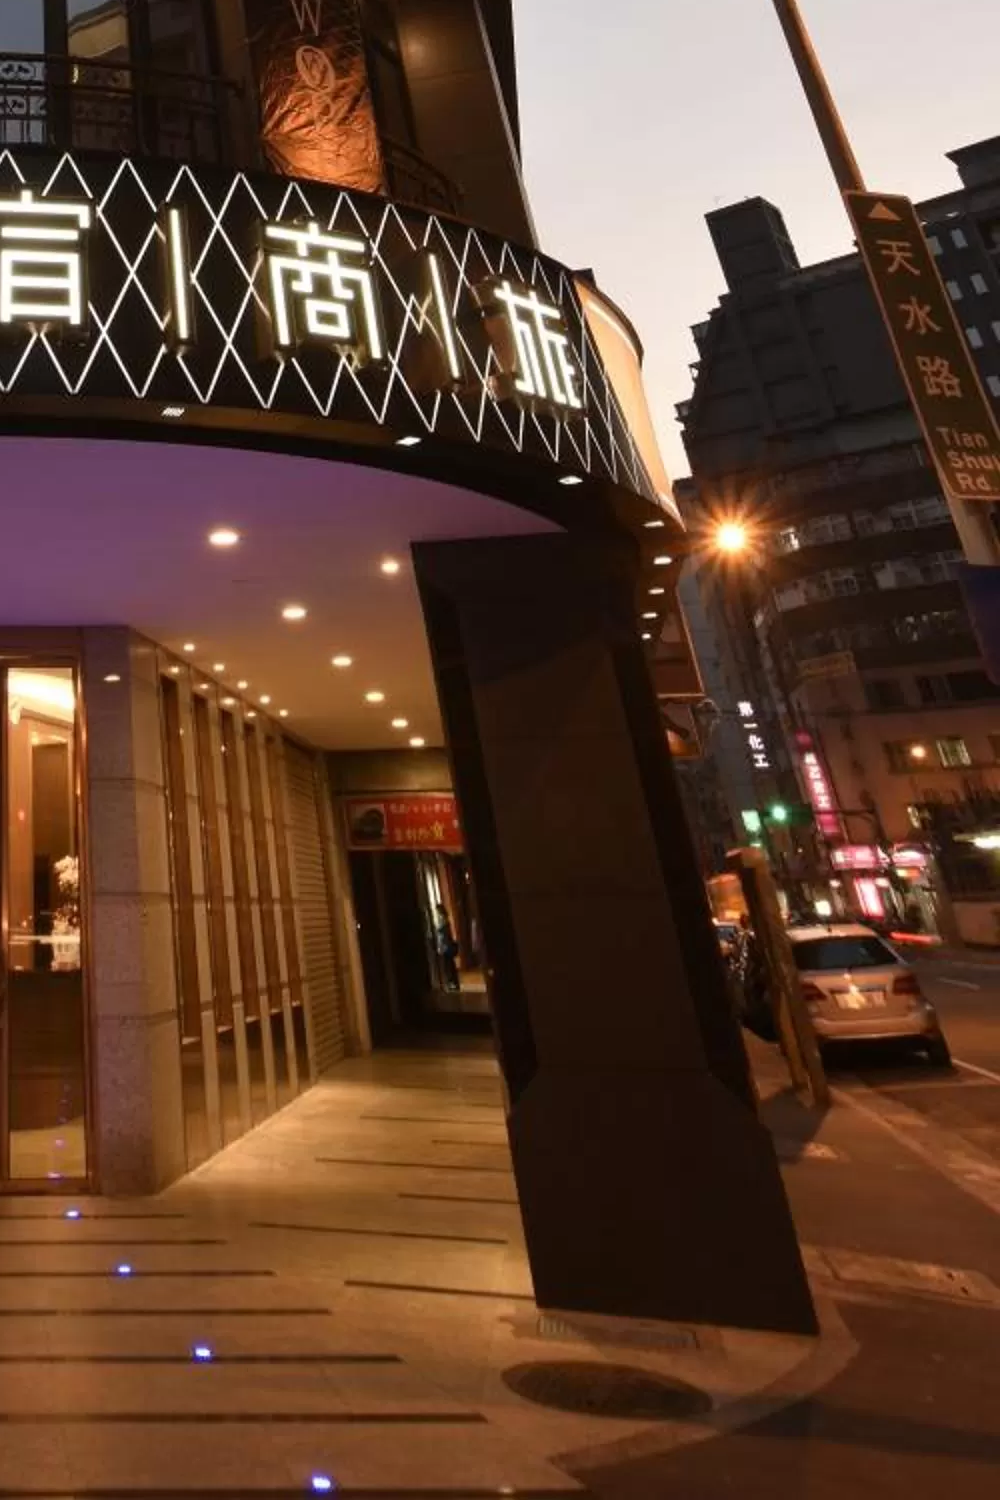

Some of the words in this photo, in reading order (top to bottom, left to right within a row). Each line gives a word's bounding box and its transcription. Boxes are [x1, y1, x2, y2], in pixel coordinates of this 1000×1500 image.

[876, 240, 962, 399] 天水路
[936, 426, 989, 448] Tian
